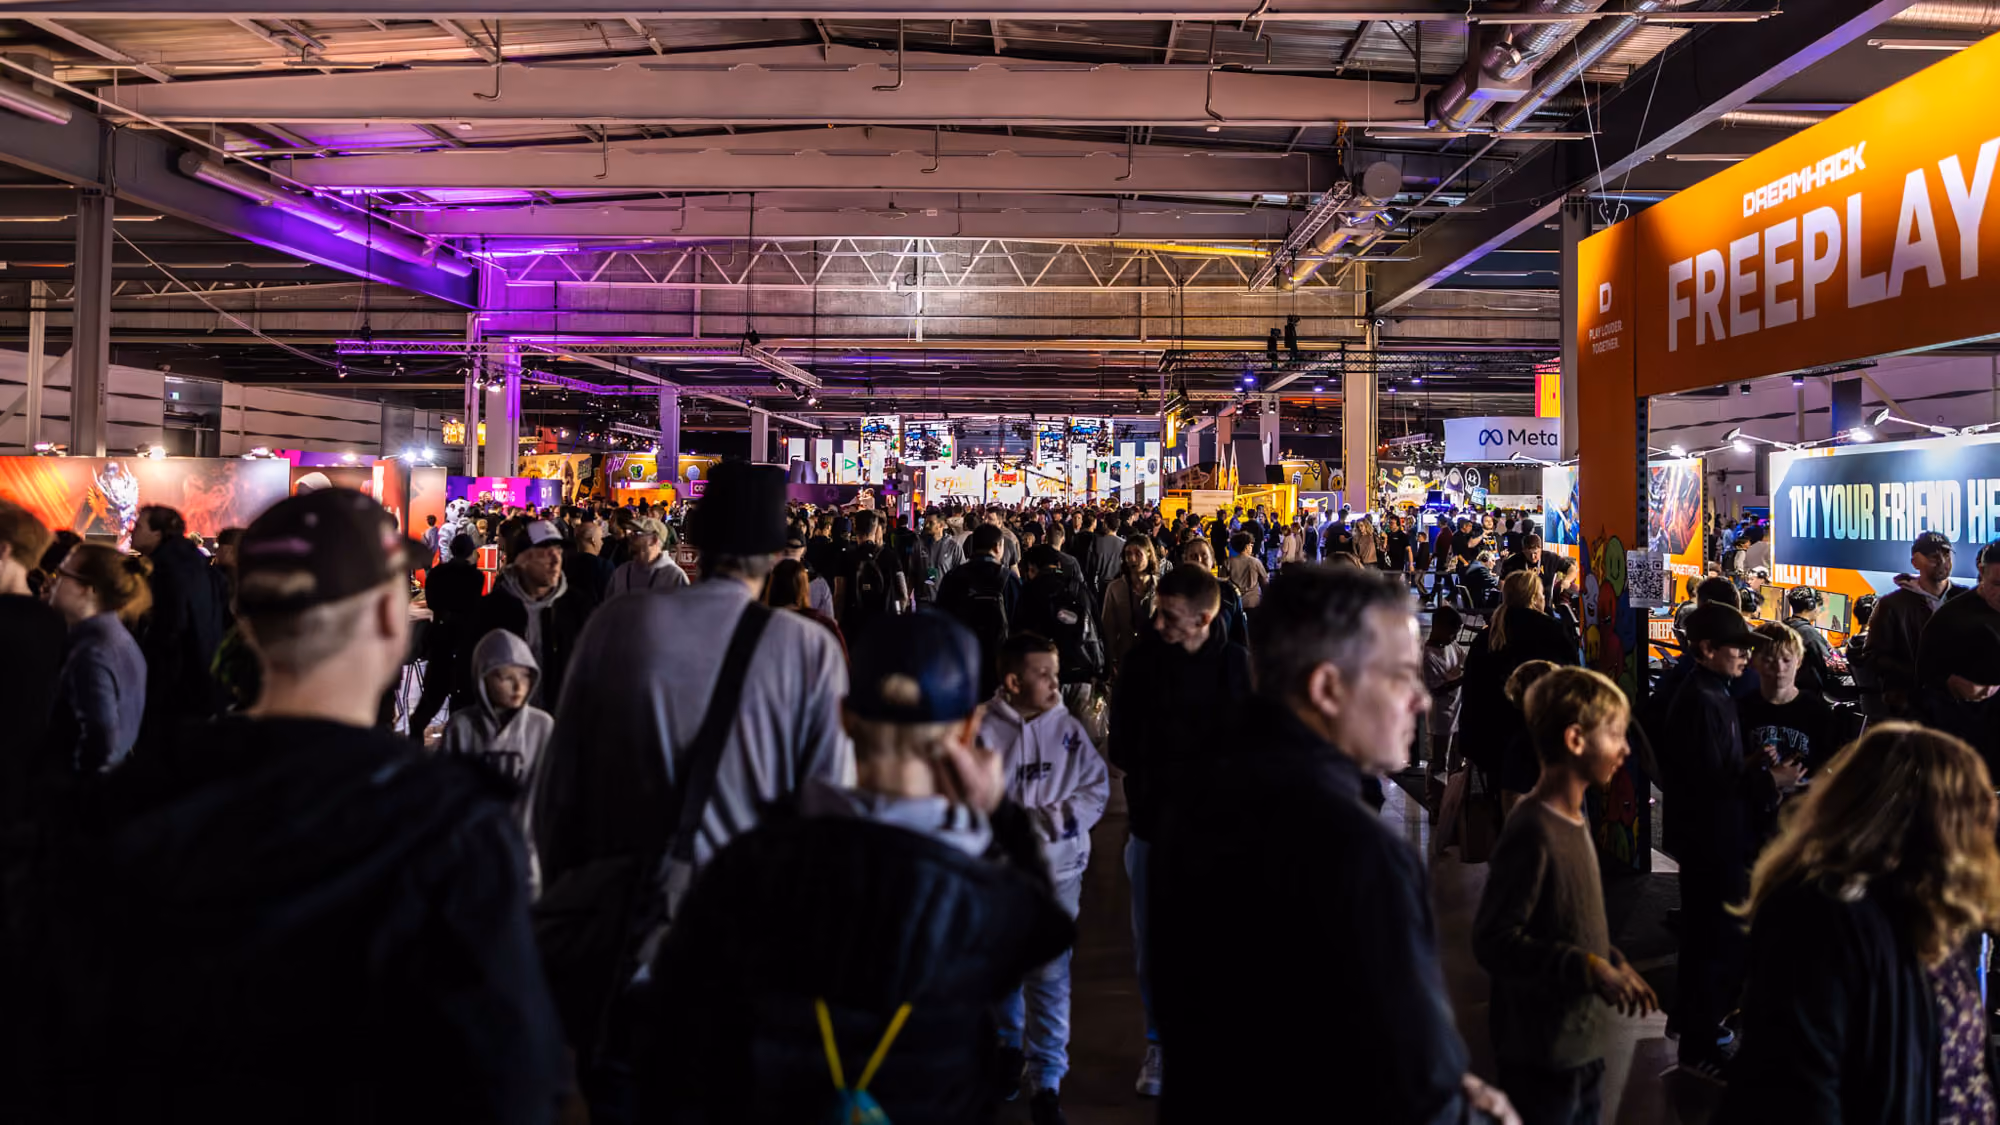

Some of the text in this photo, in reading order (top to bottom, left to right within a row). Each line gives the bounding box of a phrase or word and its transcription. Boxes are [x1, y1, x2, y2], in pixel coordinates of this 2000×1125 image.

[1743, 140, 1866, 218] DREAMHACK
[1668, 136, 2000, 352] FREEPLAY
[1599, 281, 1612, 314] D
[1589, 327, 1601, 341] PLAY
[1507, 428, 1559, 446] Meta
[1819, 484, 1875, 541] YOUR
[1879, 479, 1962, 544] FRIEND
